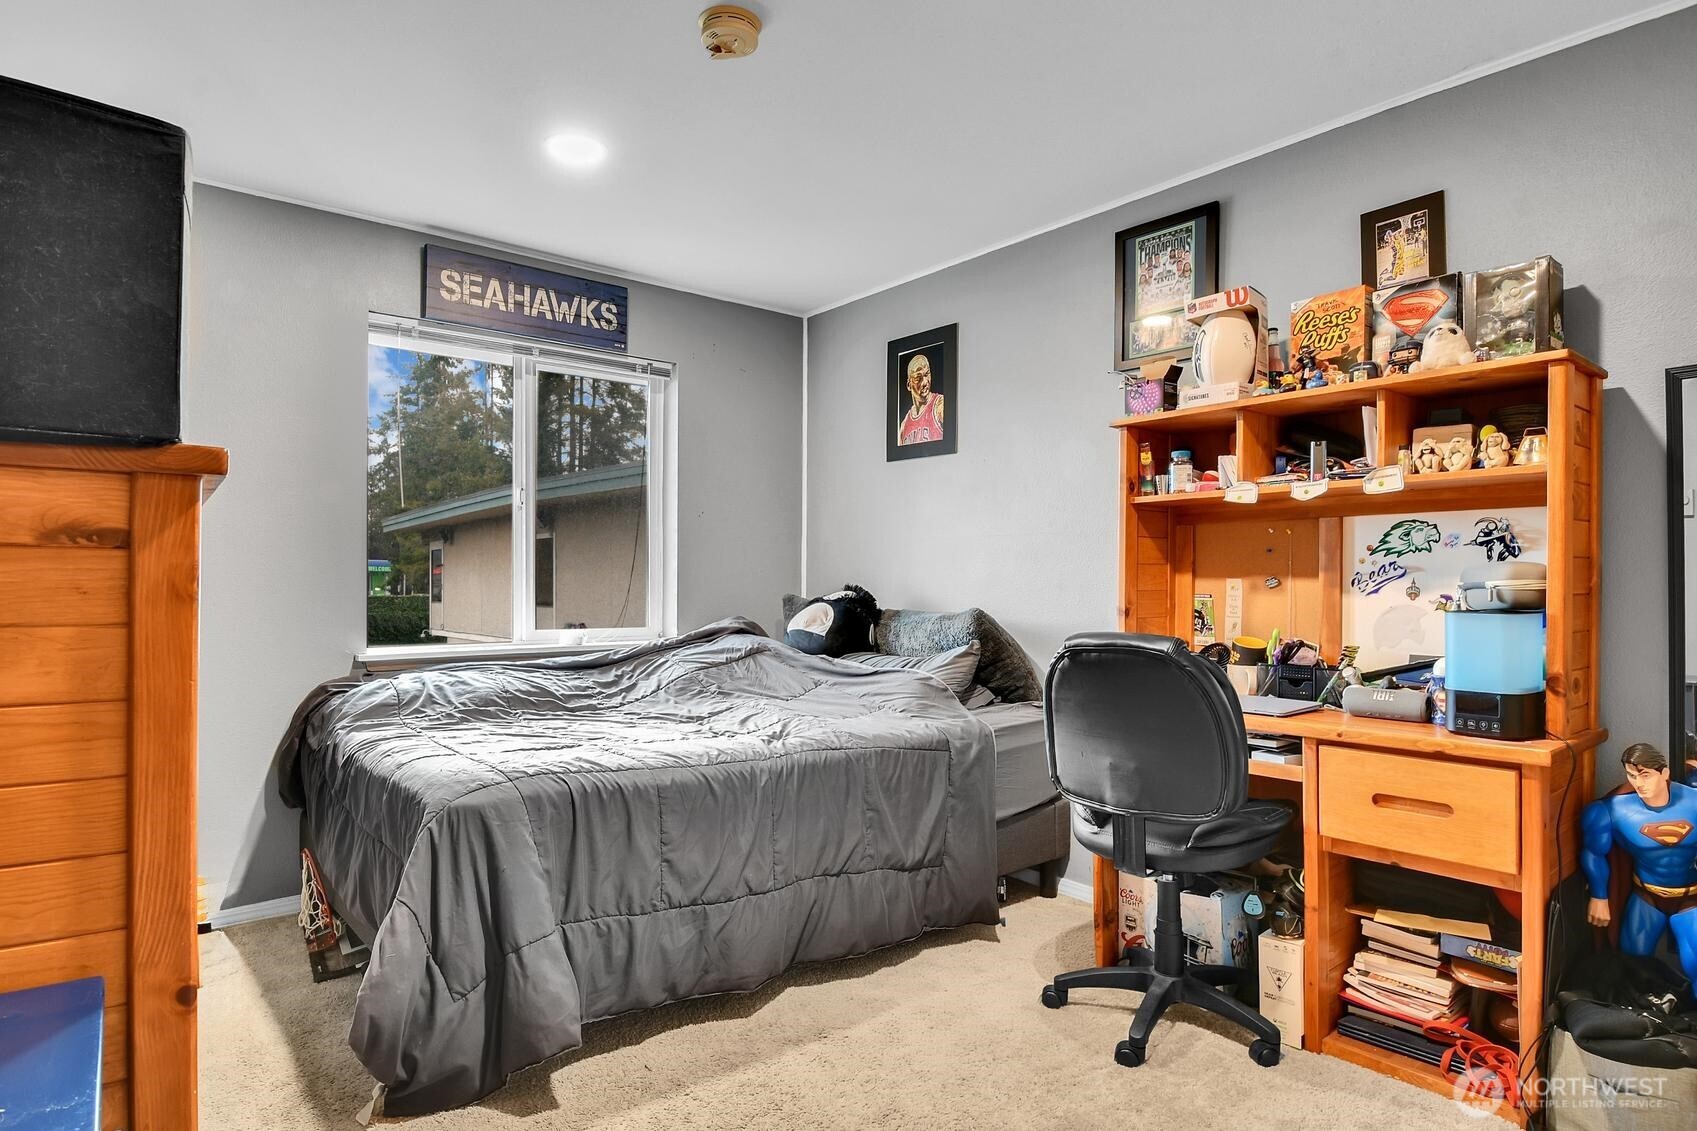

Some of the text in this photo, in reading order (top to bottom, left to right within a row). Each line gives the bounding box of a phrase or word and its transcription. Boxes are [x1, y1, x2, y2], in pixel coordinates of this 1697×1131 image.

[1139, 233, 1192, 265] CHAMPIONS
[439, 268, 618, 331] SEAHAWKS
[1293, 306, 1361, 336] Reese's
[1299, 325, 1350, 353] Puffs
[1120, 889, 1143, 904] Coors
[1122, 899, 1141, 907] LIGHT
